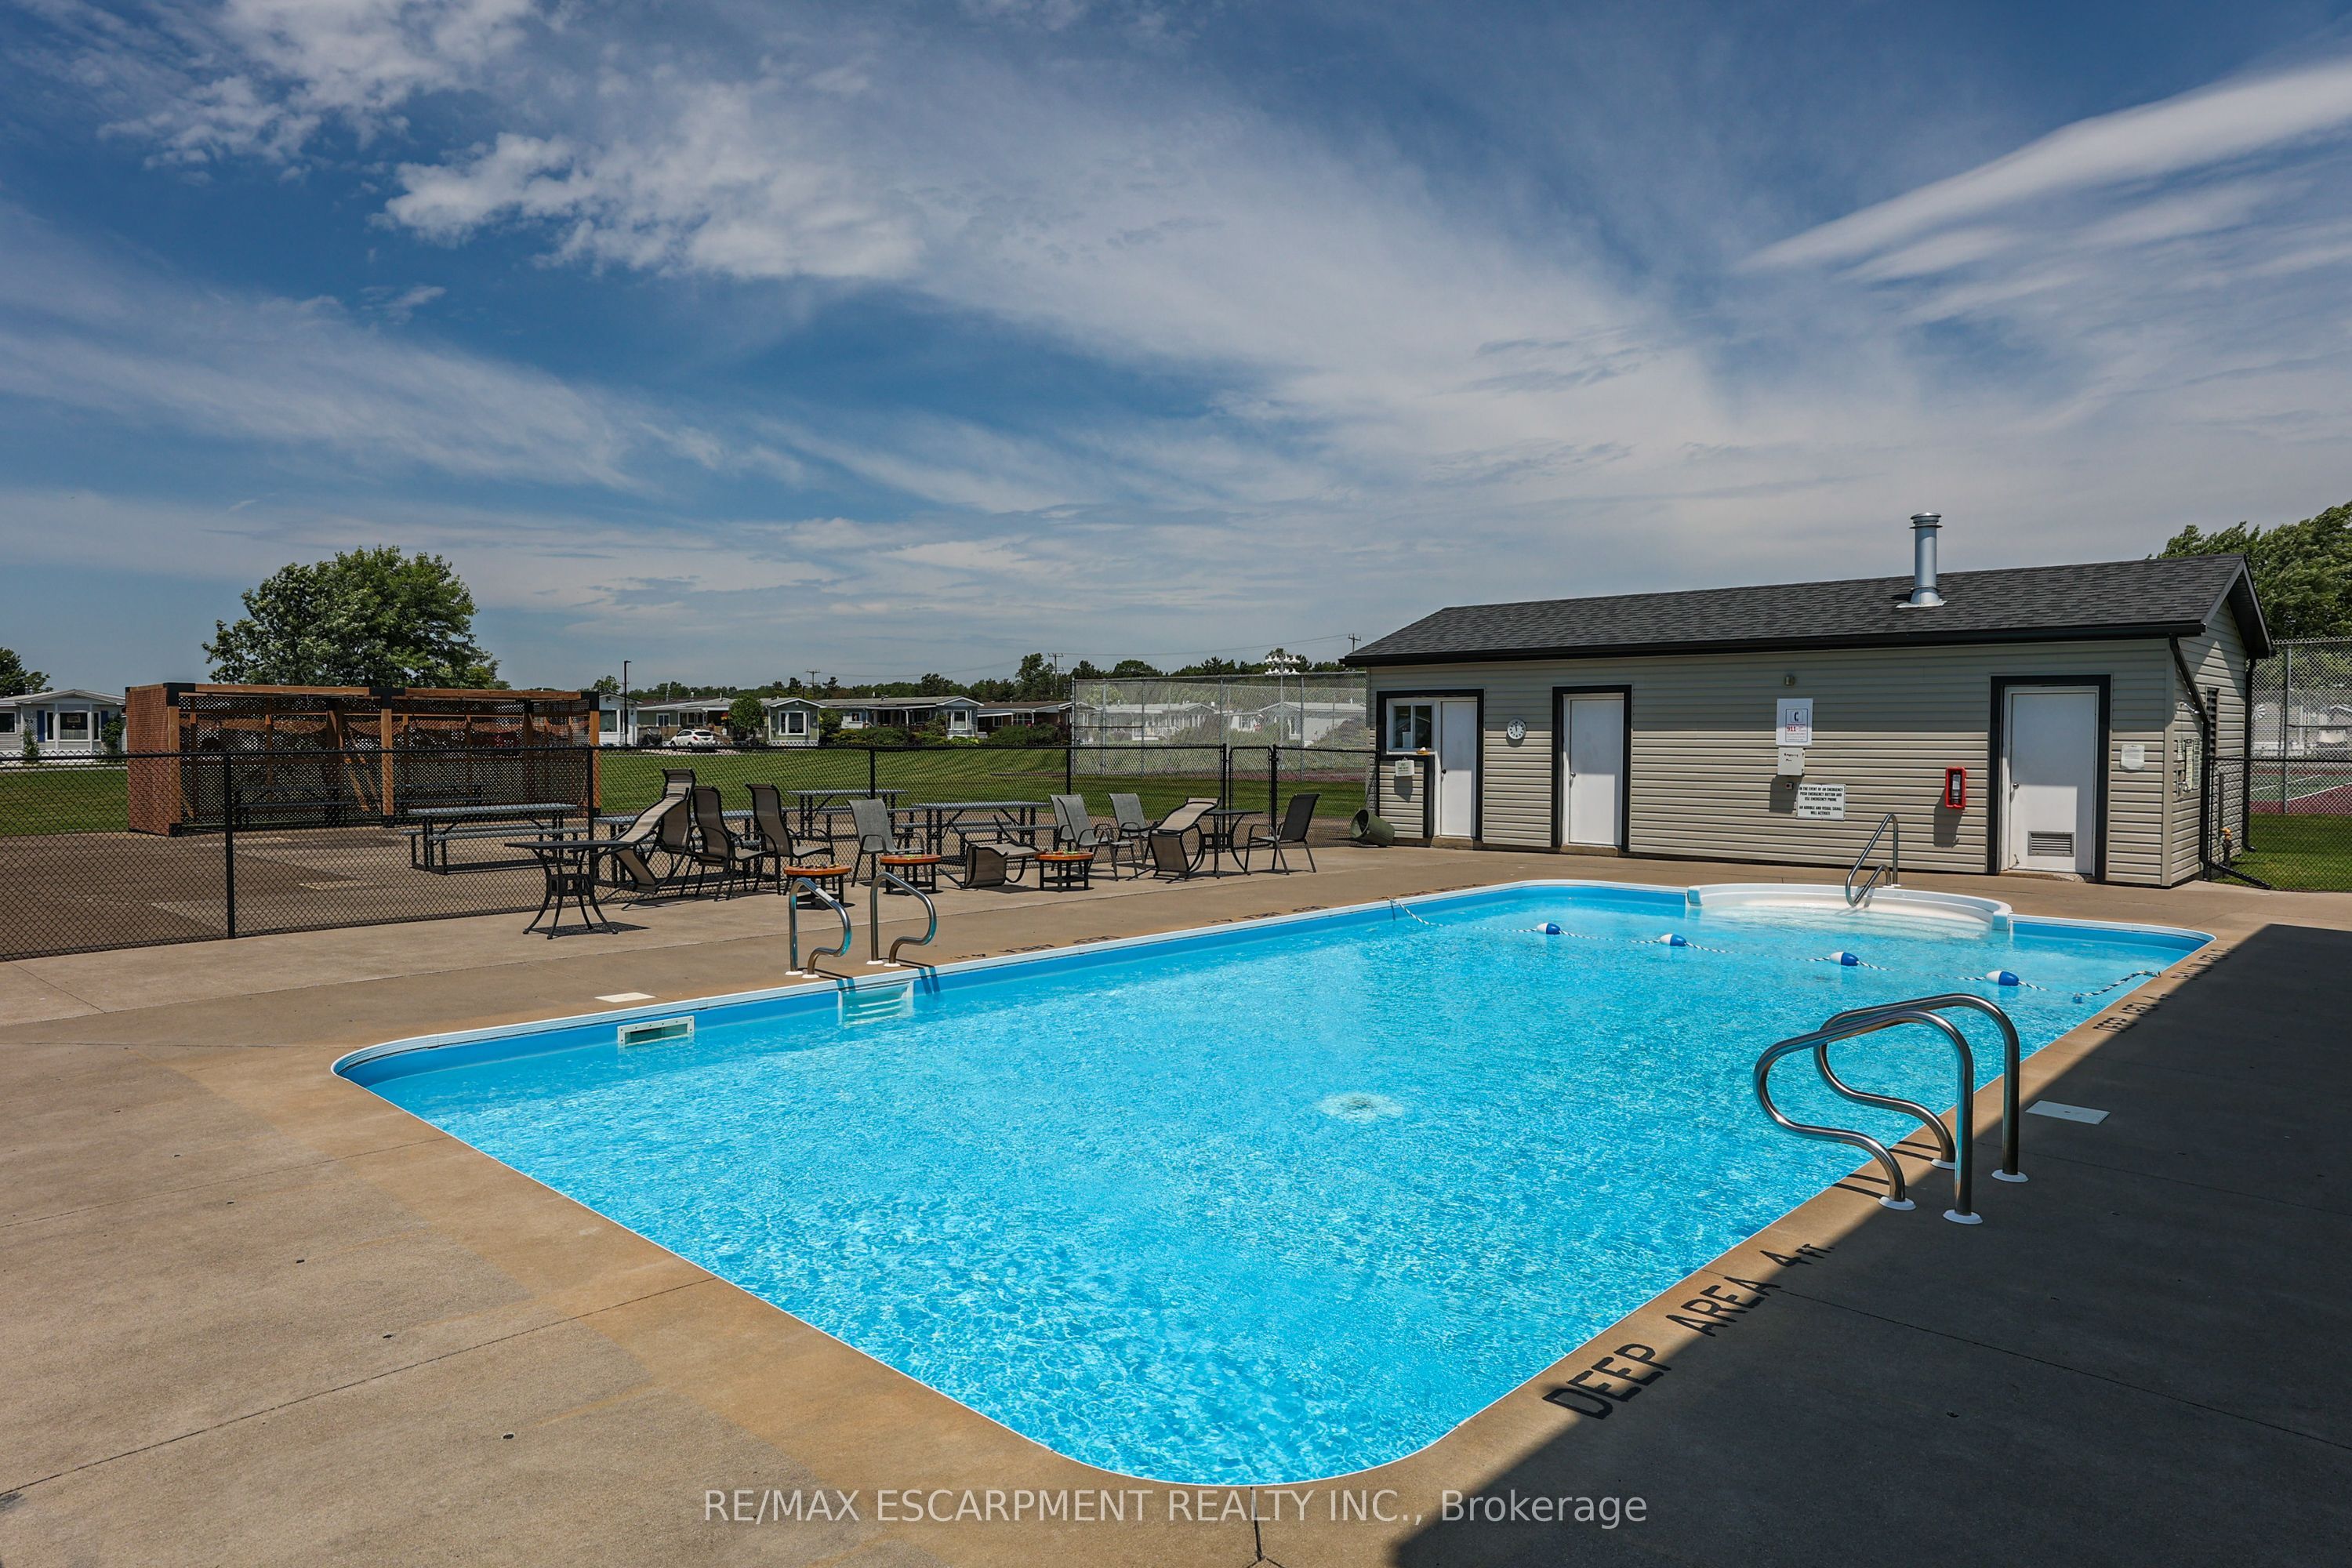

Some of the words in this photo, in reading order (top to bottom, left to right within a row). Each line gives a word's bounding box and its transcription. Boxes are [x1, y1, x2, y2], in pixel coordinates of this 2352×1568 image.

[1542, 1343, 1671, 1420] DEEP
[1665, 1276, 1781, 1337] AREA
[1759, 1250, 1813, 1267] 4
